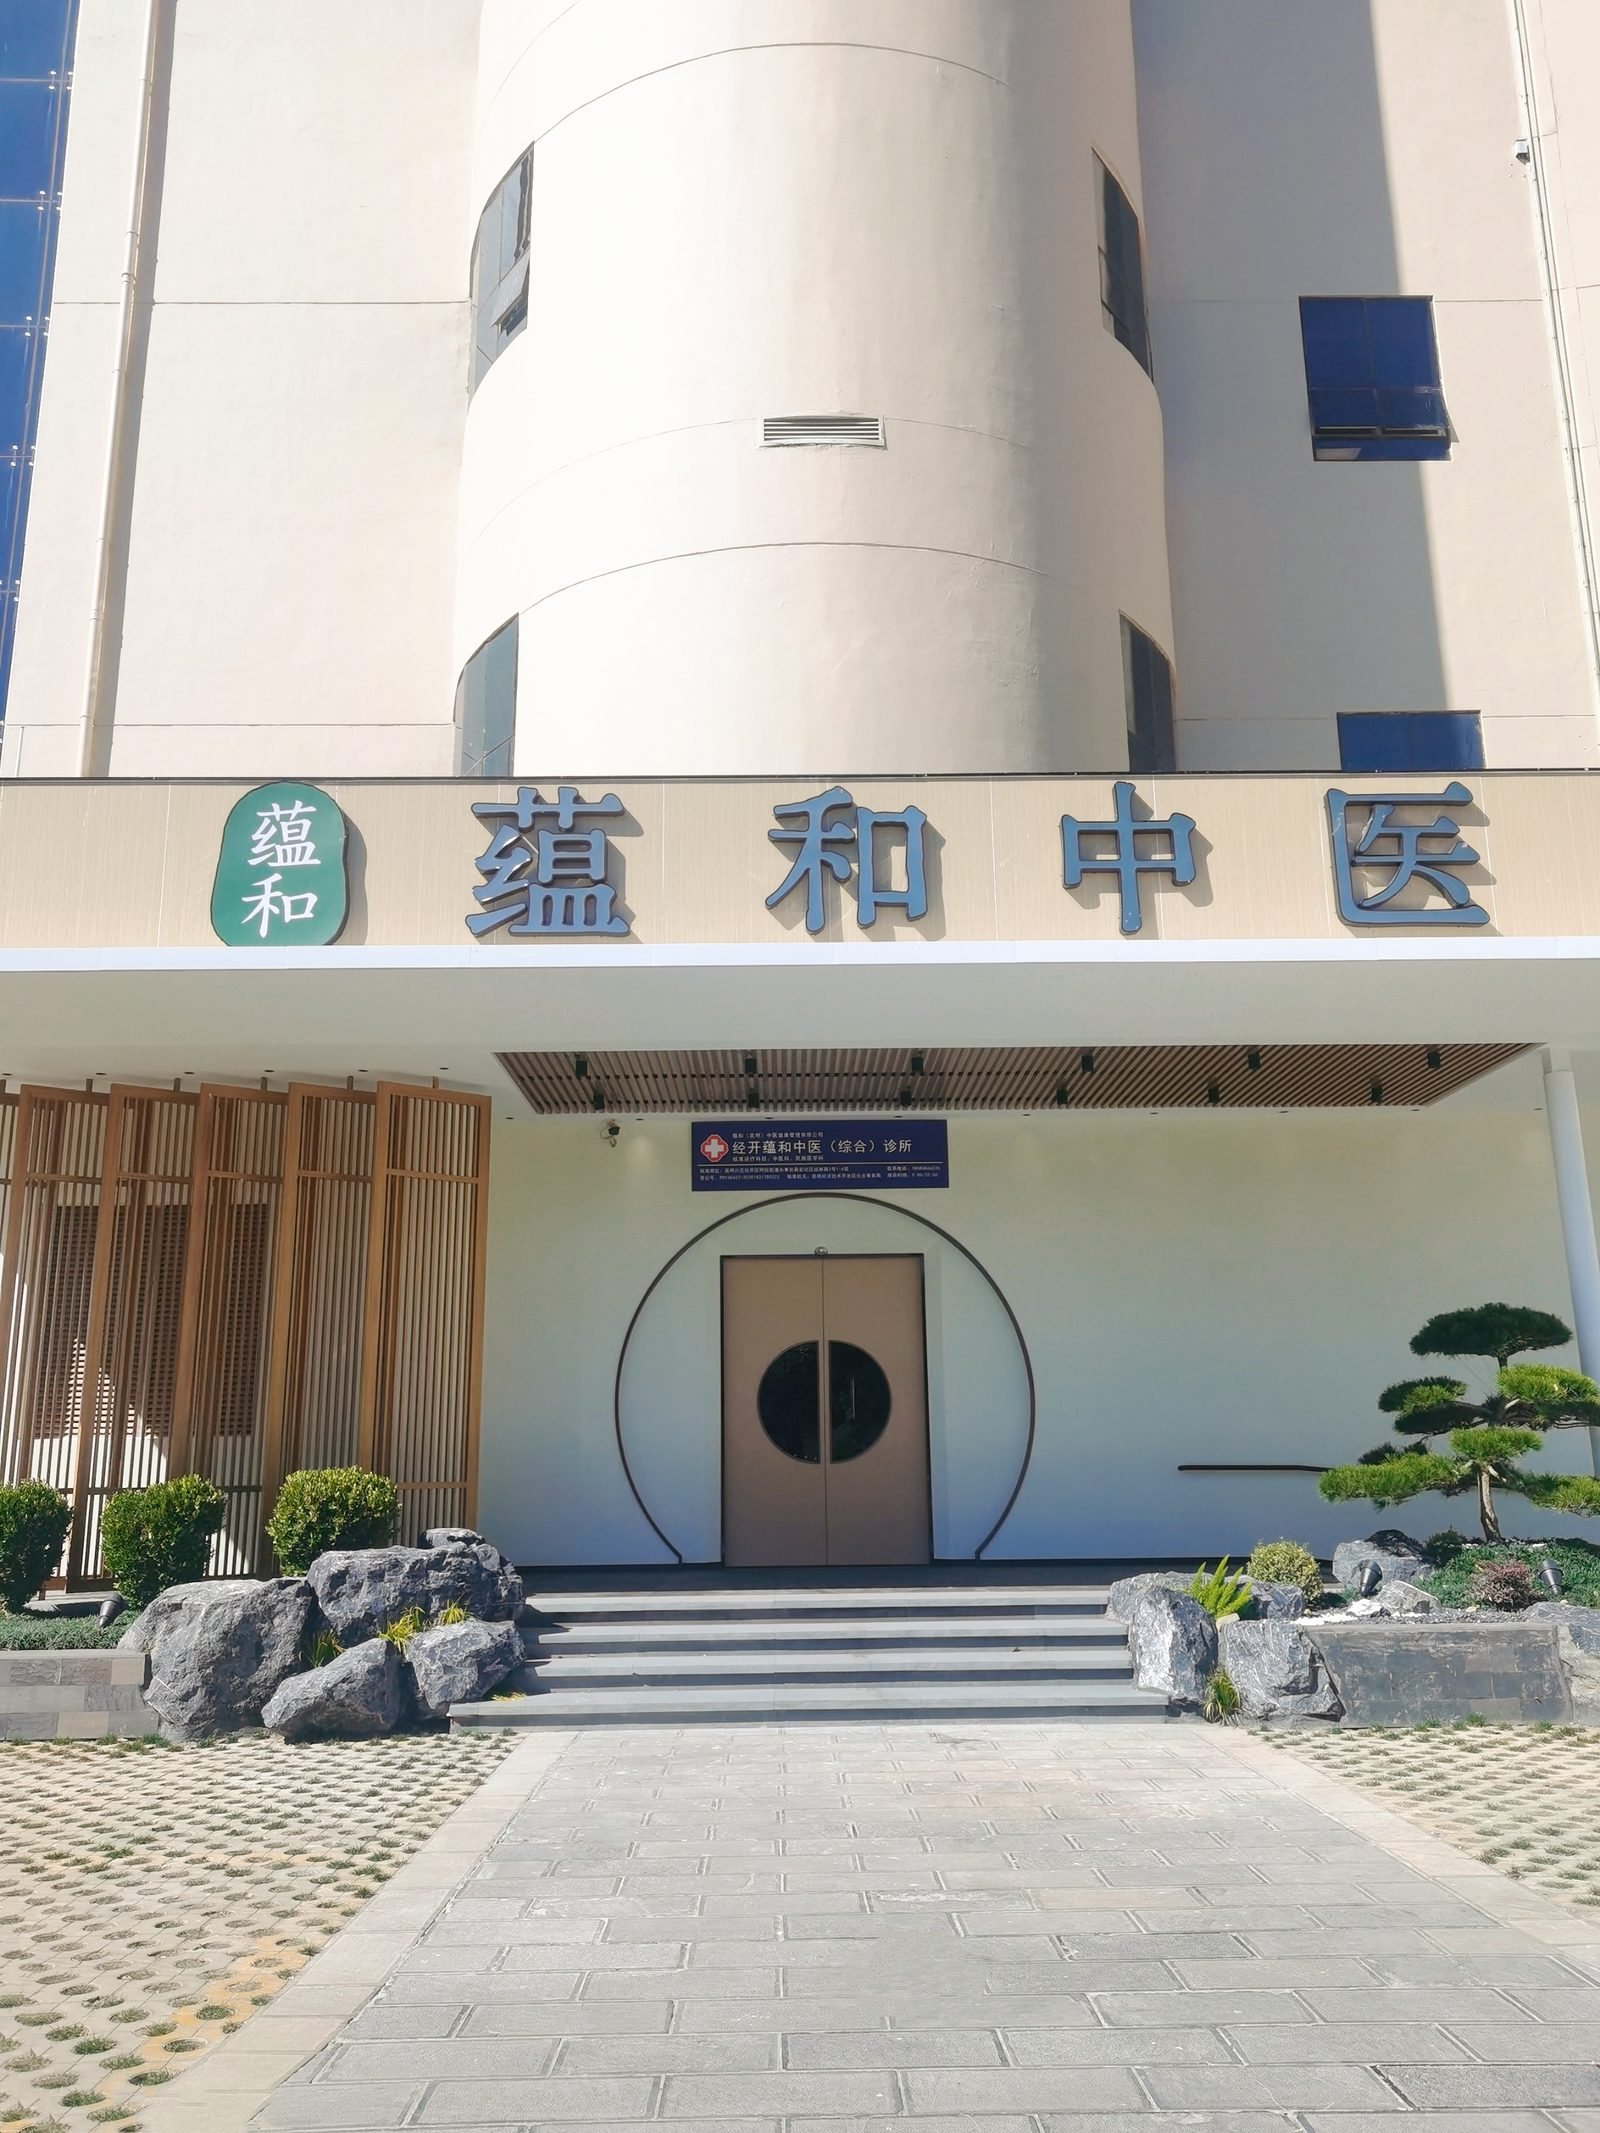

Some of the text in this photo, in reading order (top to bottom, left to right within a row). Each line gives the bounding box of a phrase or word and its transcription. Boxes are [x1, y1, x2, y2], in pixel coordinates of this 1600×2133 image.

[241, 800, 321, 938] 蕴和
[465, 781, 1490, 936] 蕴和中医
[732, 1139, 912, 1154] 经开蕴和中医（综合）诊所
